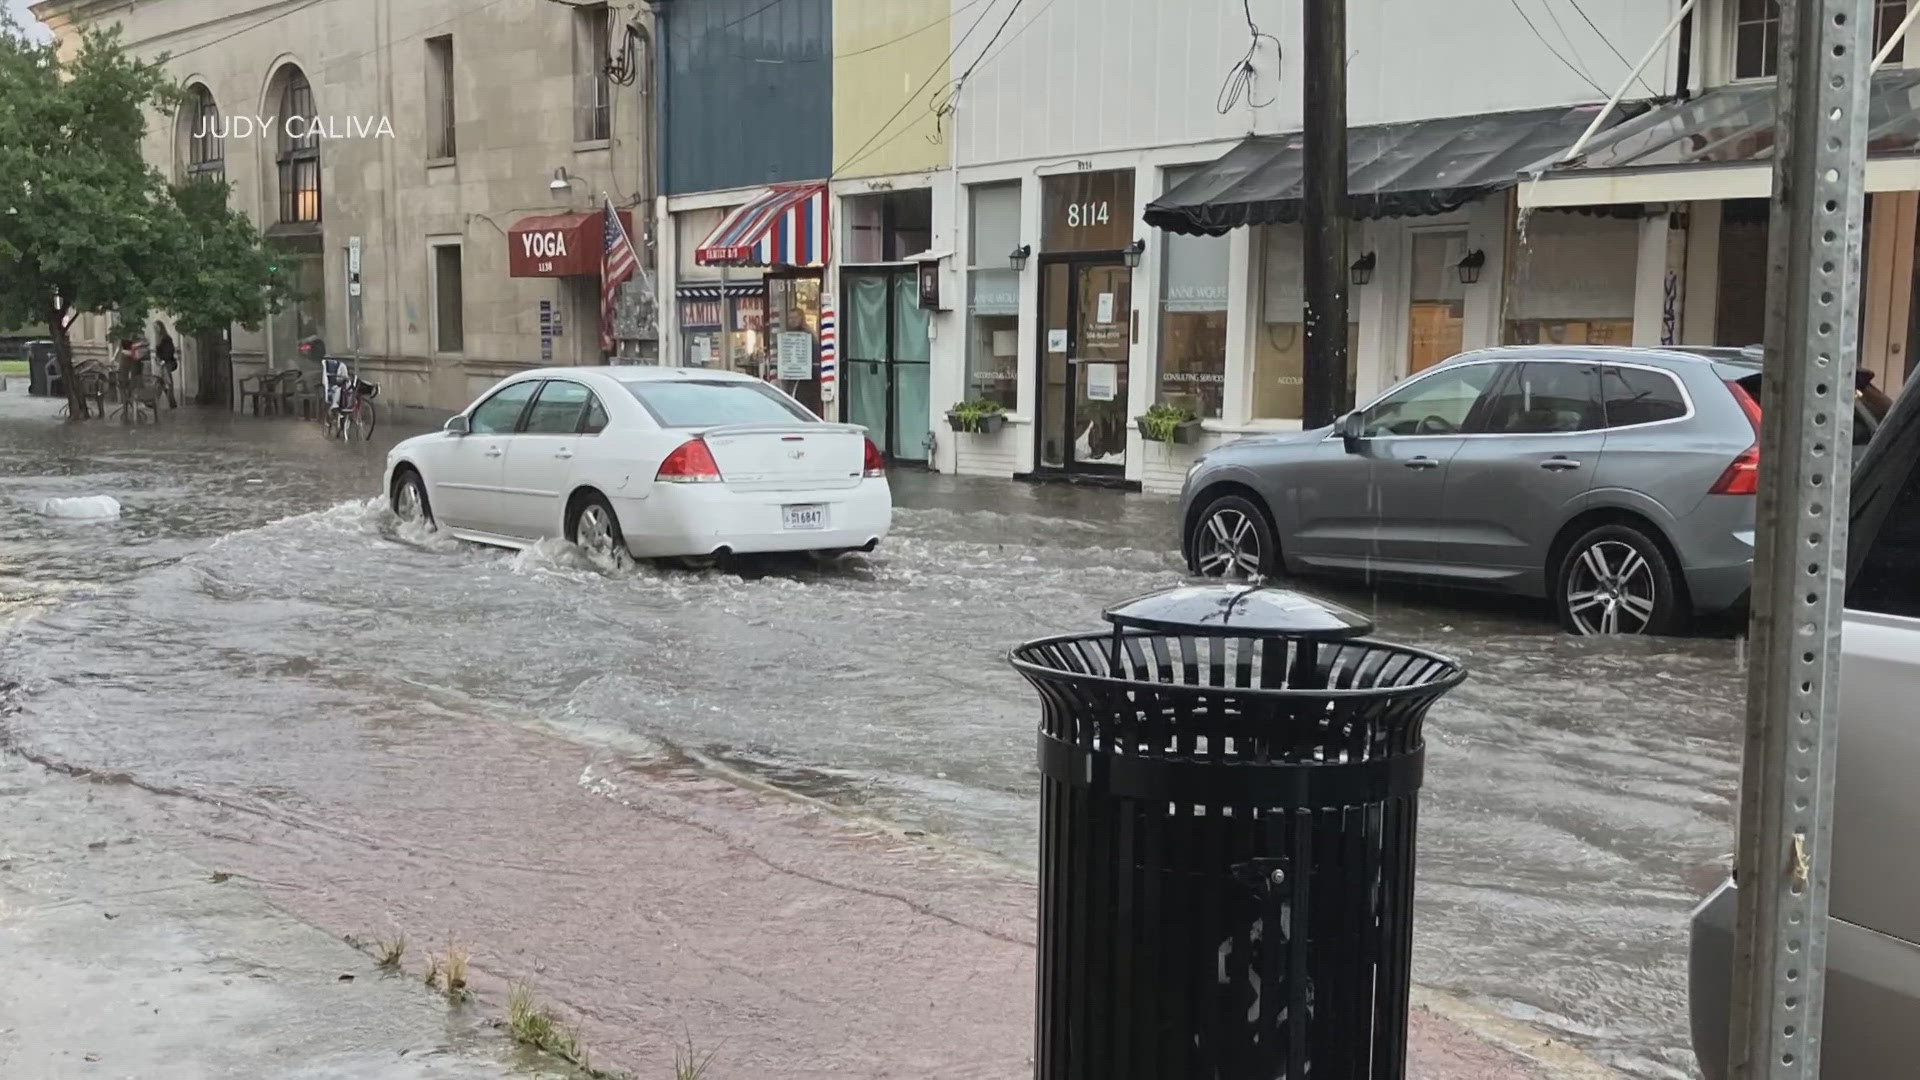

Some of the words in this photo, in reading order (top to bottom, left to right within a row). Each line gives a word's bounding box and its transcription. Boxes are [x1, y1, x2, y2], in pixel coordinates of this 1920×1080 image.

[1067, 201, 1109, 227] 8114
[522, 231, 567, 258] YOGA
[706, 249, 726, 259] FAMILY
[1168, 287, 1195, 299] ANNE
[682, 302, 721, 324] FAMILY
